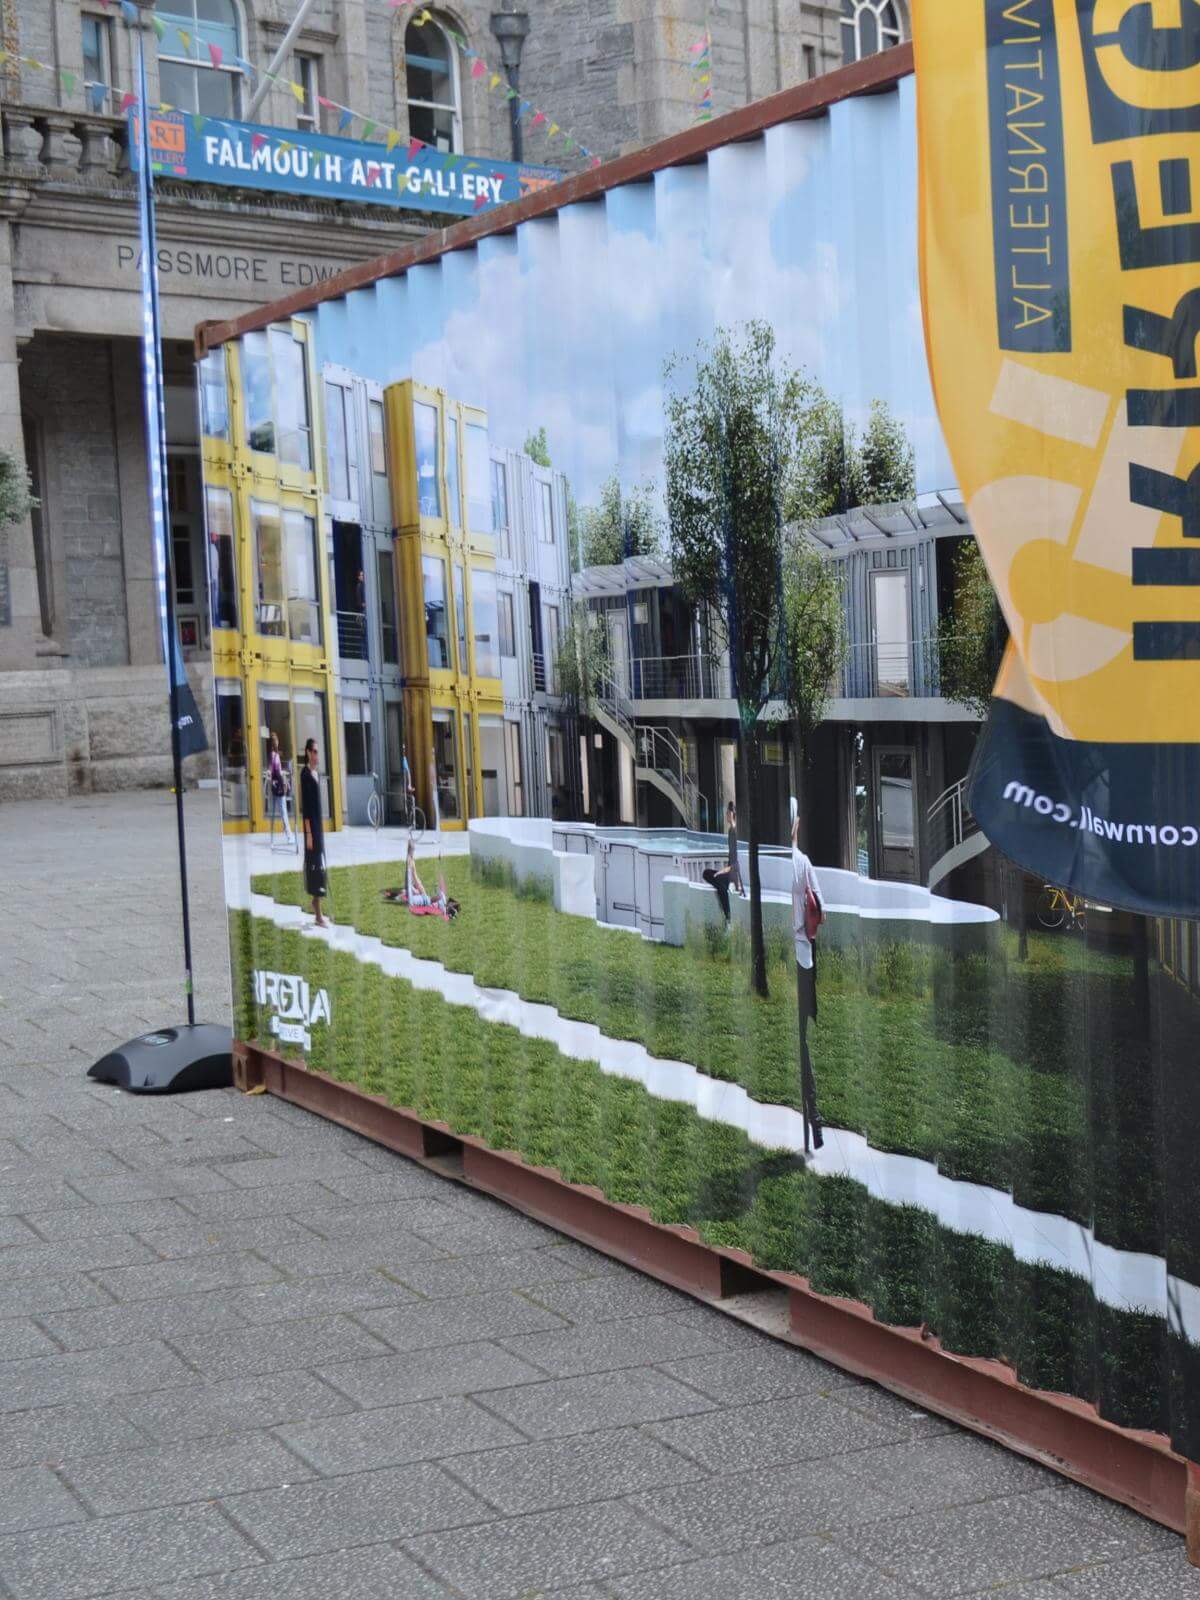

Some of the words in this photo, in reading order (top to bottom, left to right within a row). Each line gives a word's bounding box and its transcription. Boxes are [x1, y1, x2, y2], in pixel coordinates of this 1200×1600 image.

[351, 158, 395, 190] ART
[405, 166, 503, 203] GALLERY
[117, 245, 268, 282] PSSMORE
